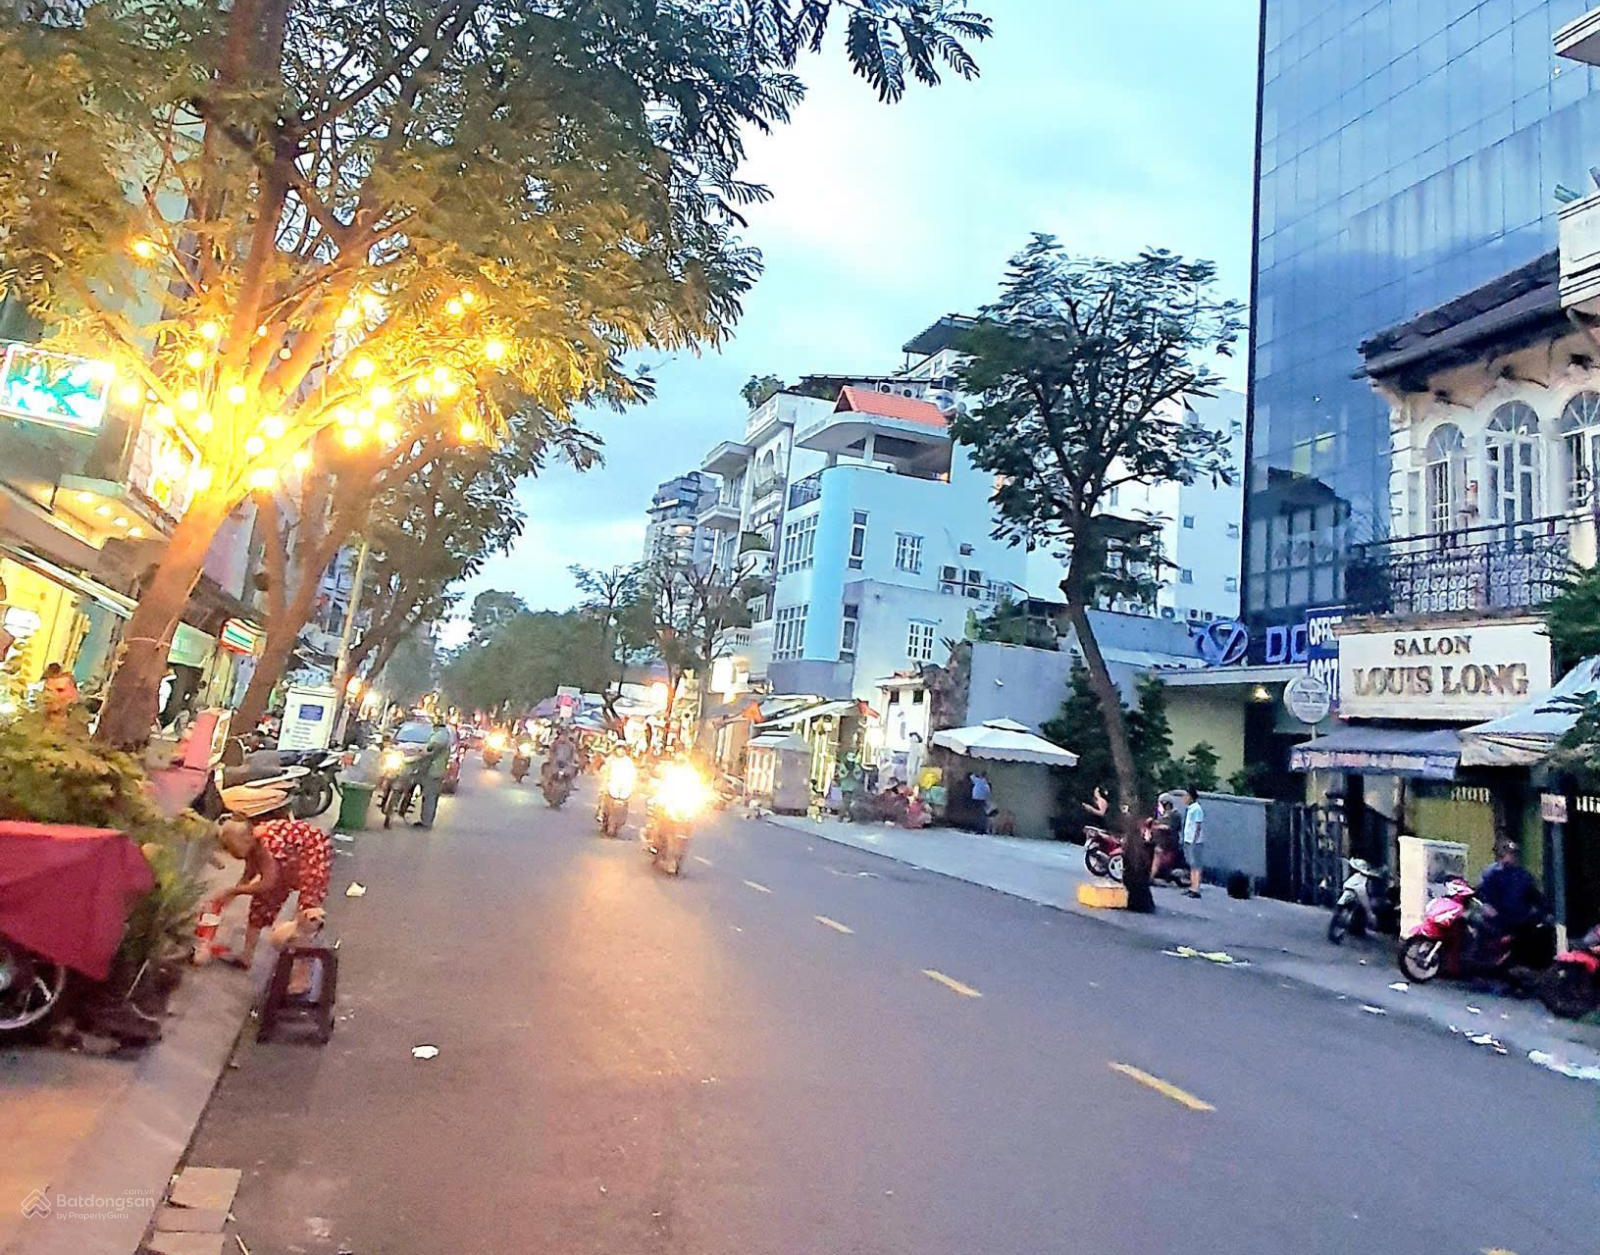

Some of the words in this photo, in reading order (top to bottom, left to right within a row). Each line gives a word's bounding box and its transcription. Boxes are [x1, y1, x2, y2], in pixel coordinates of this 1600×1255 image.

[1394, 634, 1472, 656] SALON
[1353, 665, 1433, 697] LOUIS
[1440, 663, 1530, 696] LONG
